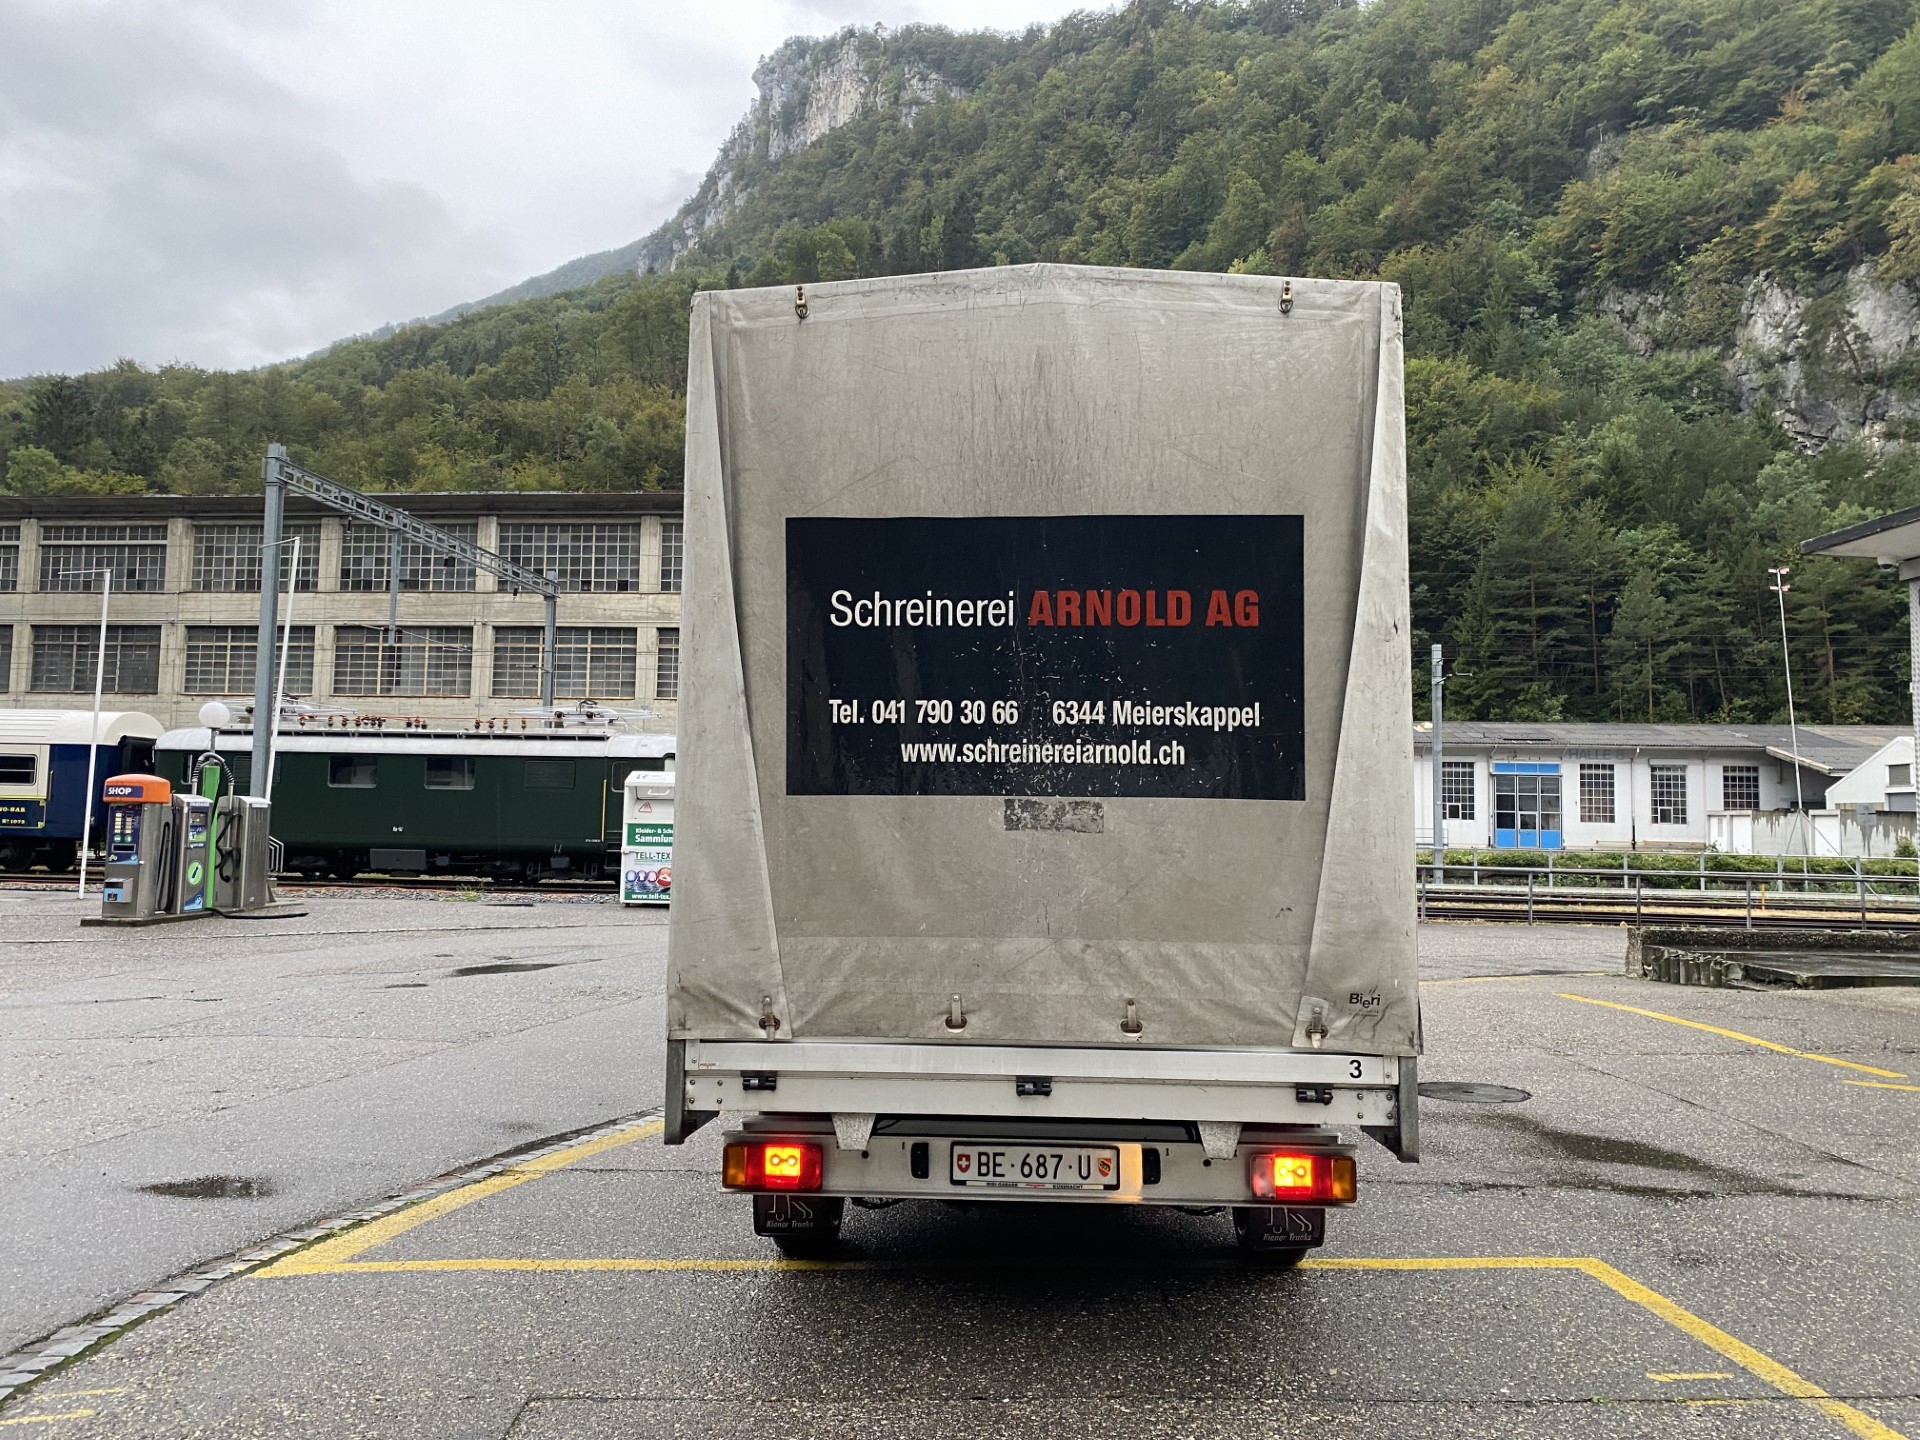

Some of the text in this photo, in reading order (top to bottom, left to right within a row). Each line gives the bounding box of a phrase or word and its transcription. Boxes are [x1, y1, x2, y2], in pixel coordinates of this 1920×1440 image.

[829, 589, 1260, 627] Schreinerei ARNOLD AG
[829, 699, 1260, 732] Tel. 041 790 30 66 6344 Meierskappel
[901, 738, 1186, 766] www.schreinereiarnold.ch
[1569, 749, 1612, 760] HALLE
[108, 787, 132, 795] SHOP
[634, 852, 671, 860] TELL-TEX
[1349, 993, 1381, 1008] Bieri
[1349, 1059, 1362, 1079] 3
[791, 1220, 814, 1228] Trucks
[1289, 1233, 1312, 1241] Trucks
